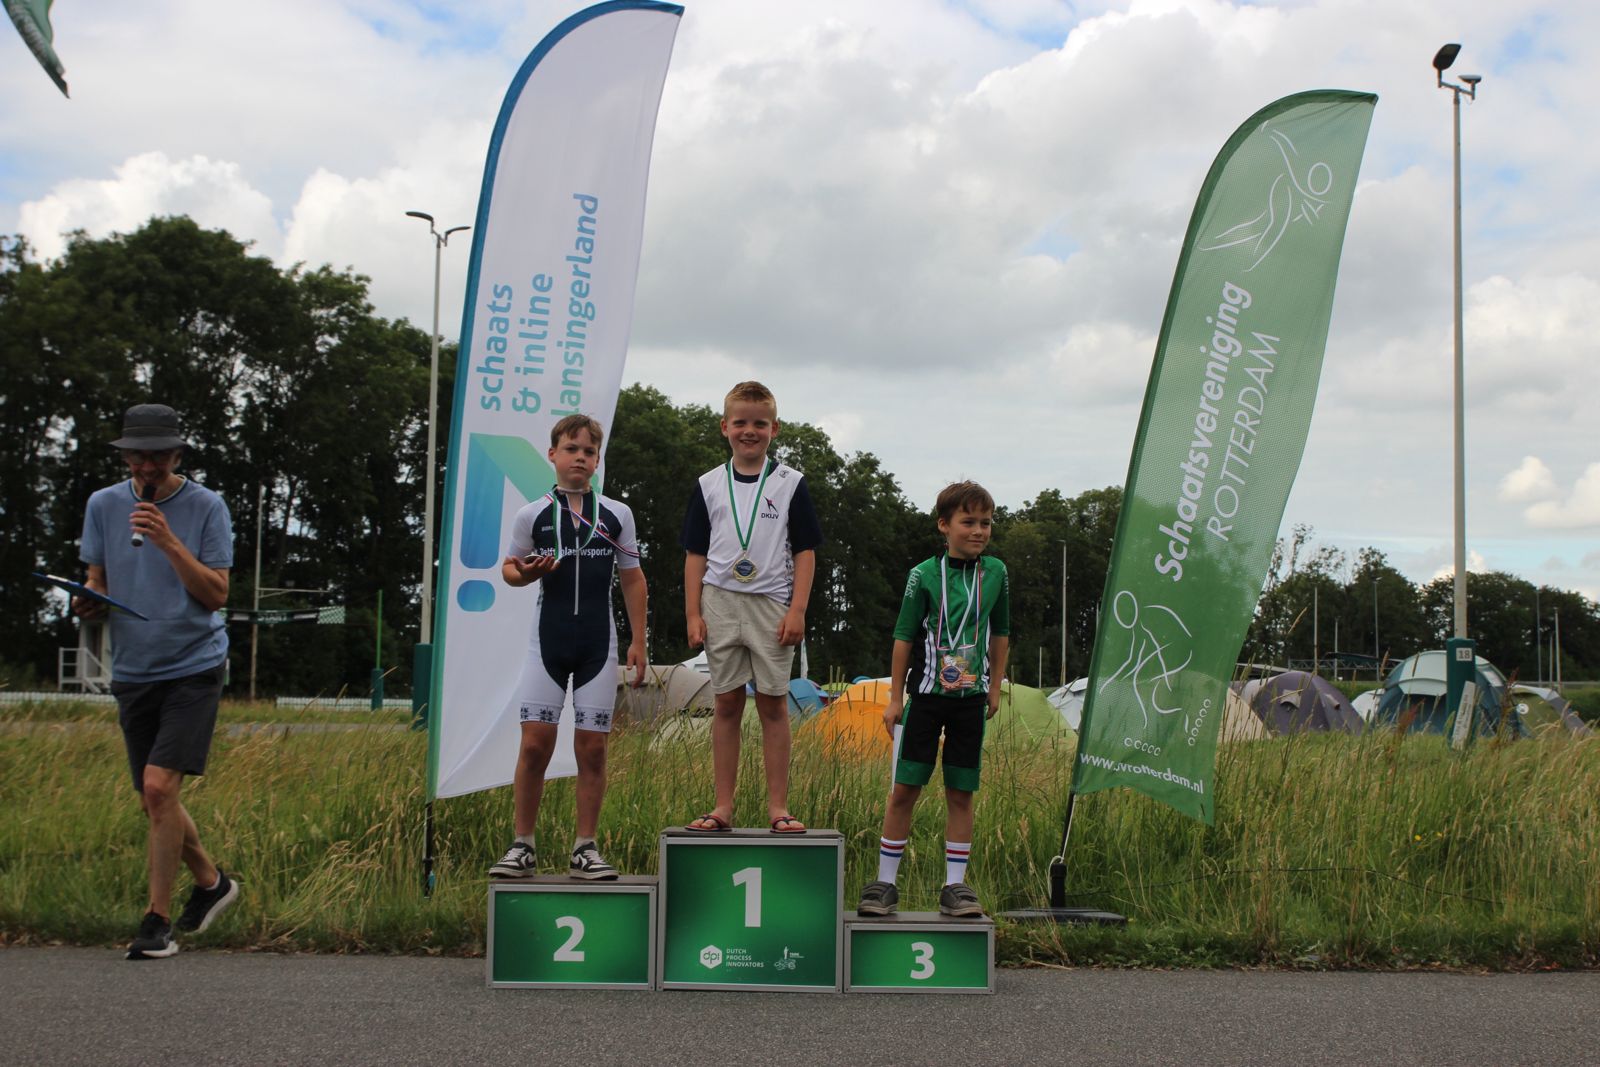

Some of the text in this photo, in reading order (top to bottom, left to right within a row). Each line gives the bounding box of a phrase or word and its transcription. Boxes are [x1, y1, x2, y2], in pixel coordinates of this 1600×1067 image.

[551, 193, 599, 416] lansingerland
[476, 284, 513, 411] schaats
[511, 273, 553, 414] & inline
[1154, 281, 1252, 582] Schaatsvereniging
[1207, 331, 1281, 541] ROTTERDAM
[905, 566, 921, 598] SPORT
[1459, 650, 1470, 659] 18
[1080, 753, 1204, 794] www.svrotterdam.nl
[732, 867, 762, 928] 1
[553, 916, 585, 962] 2
[909, 941, 936, 979] 3
